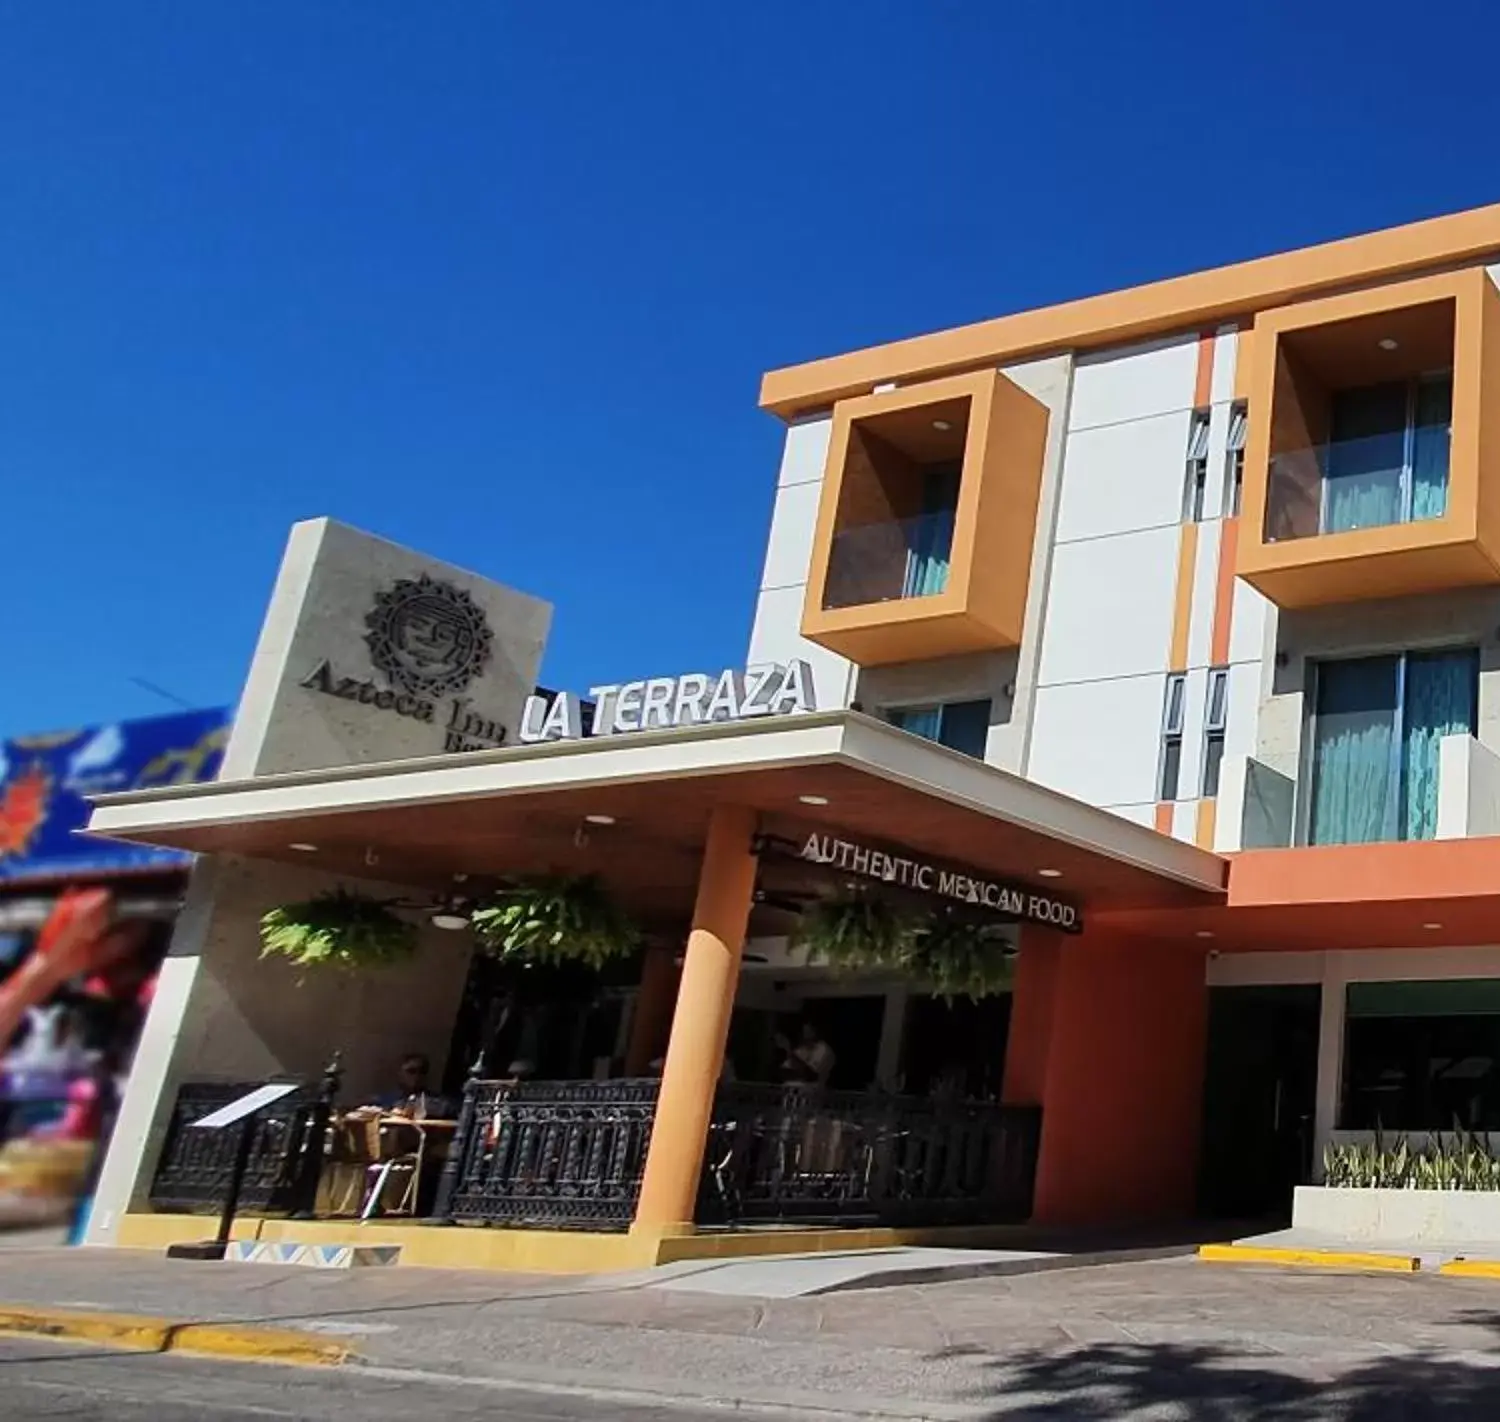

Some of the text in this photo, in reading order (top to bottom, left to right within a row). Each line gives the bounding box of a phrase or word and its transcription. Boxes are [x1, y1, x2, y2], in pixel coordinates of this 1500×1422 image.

[300, 658, 507, 743] Azteca Inn
[519, 658, 816, 742] LA TERRAZA
[800, 833, 1076, 927] AUTHENTIC MEXICAN FOOD
